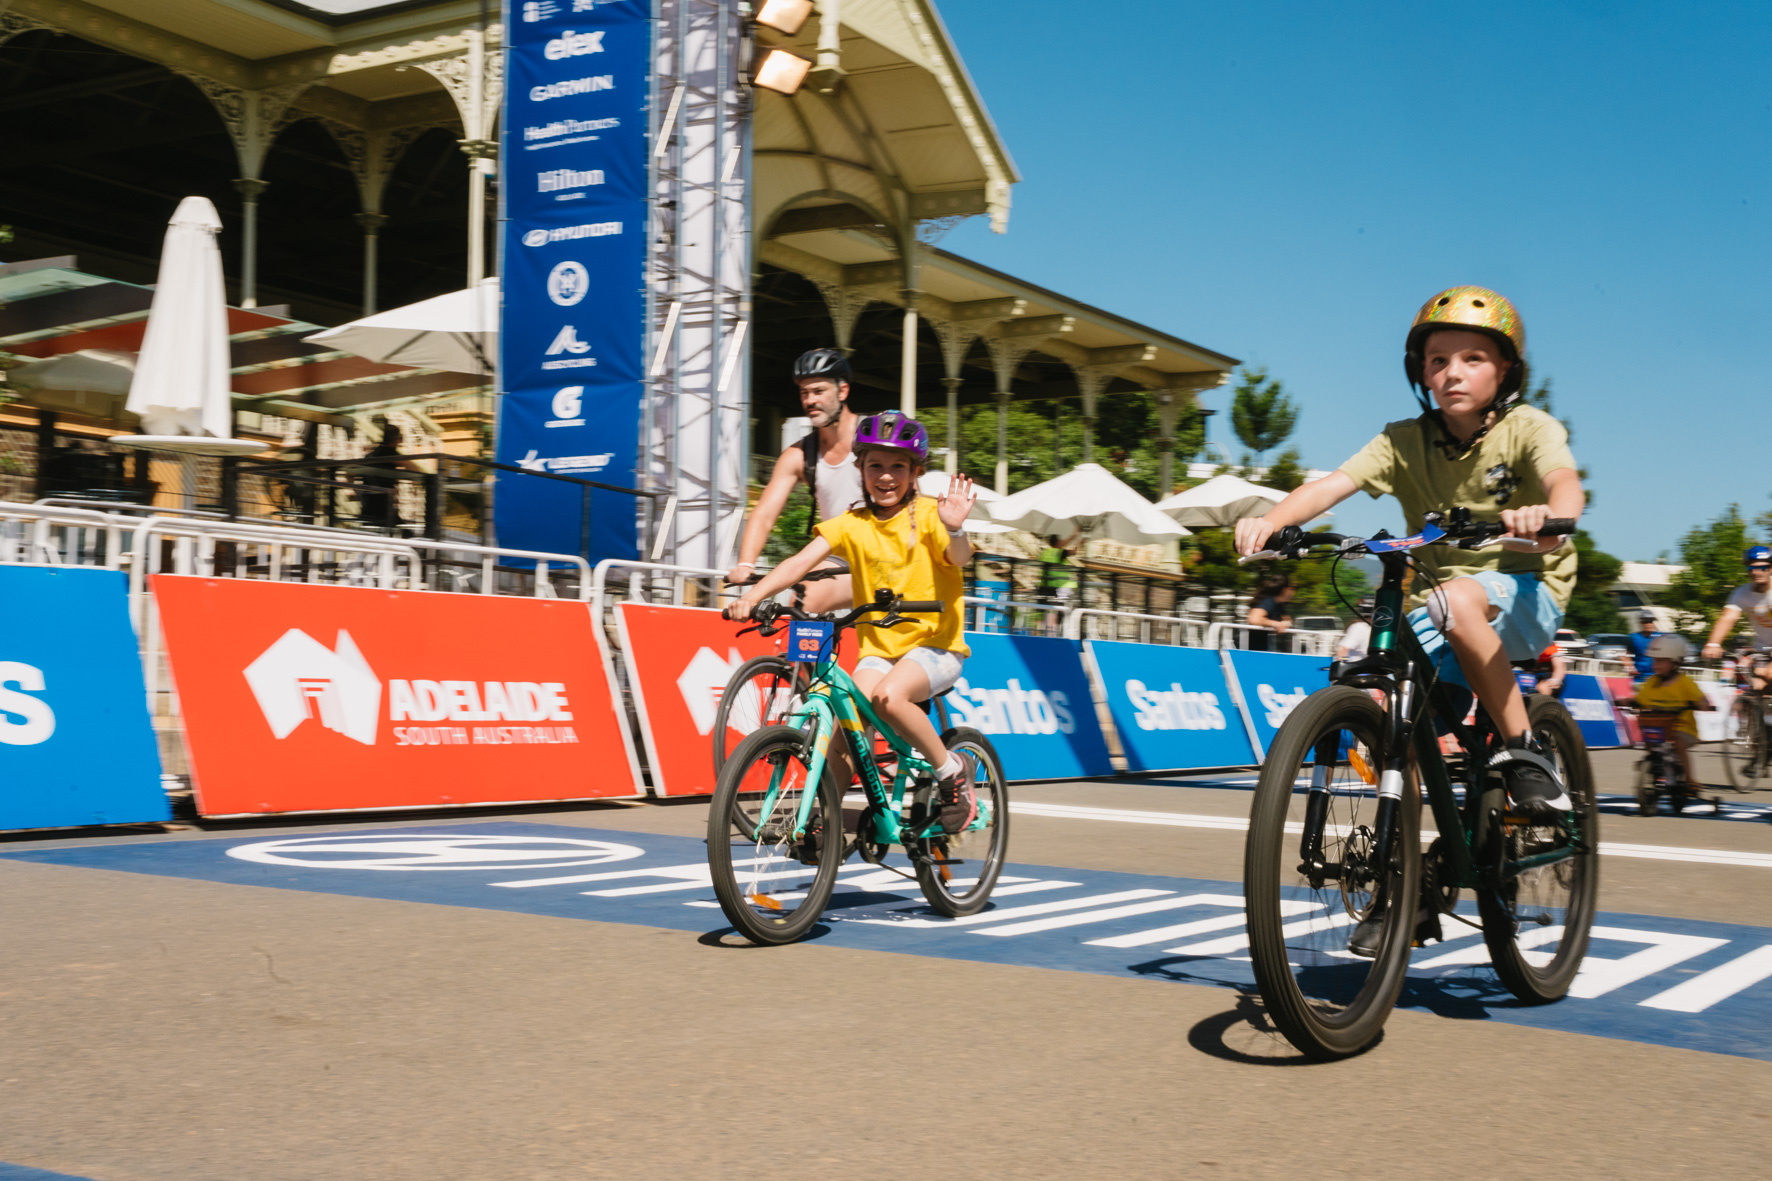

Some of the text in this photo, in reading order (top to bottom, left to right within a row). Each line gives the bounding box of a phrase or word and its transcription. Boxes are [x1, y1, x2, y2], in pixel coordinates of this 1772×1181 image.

[798, 638, 820, 651] 63
[389, 679, 574, 721] ADELAIDE
[945, 676, 1075, 735] Santos
[1124, 679, 1227, 731] Santos
[393, 727, 580, 745] SOUTH AUSTRALIA
[851, 730, 885, 804] POLYGON
